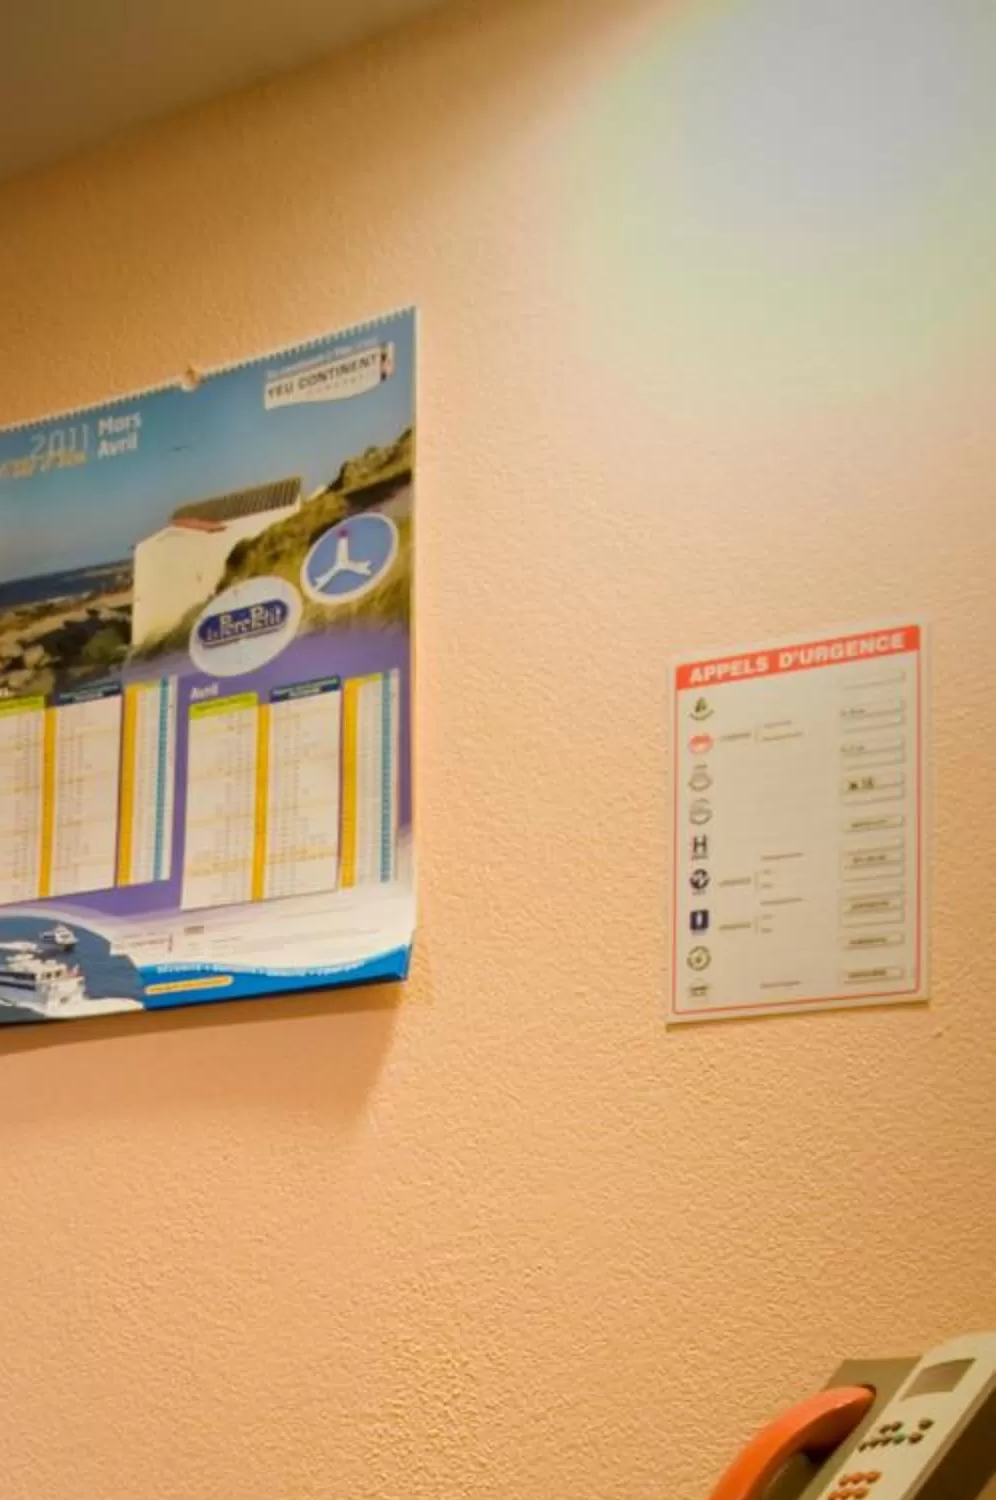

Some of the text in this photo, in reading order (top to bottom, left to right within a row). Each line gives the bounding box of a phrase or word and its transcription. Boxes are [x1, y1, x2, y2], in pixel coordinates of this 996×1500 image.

[298, 353, 377, 390] CONTINENT
[29, 423, 90, 459] 2011
[98, 412, 142, 436] Mars
[98, 432, 138, 459] Avril
[689, 633, 905, 685] APPELS D'URGENCE
